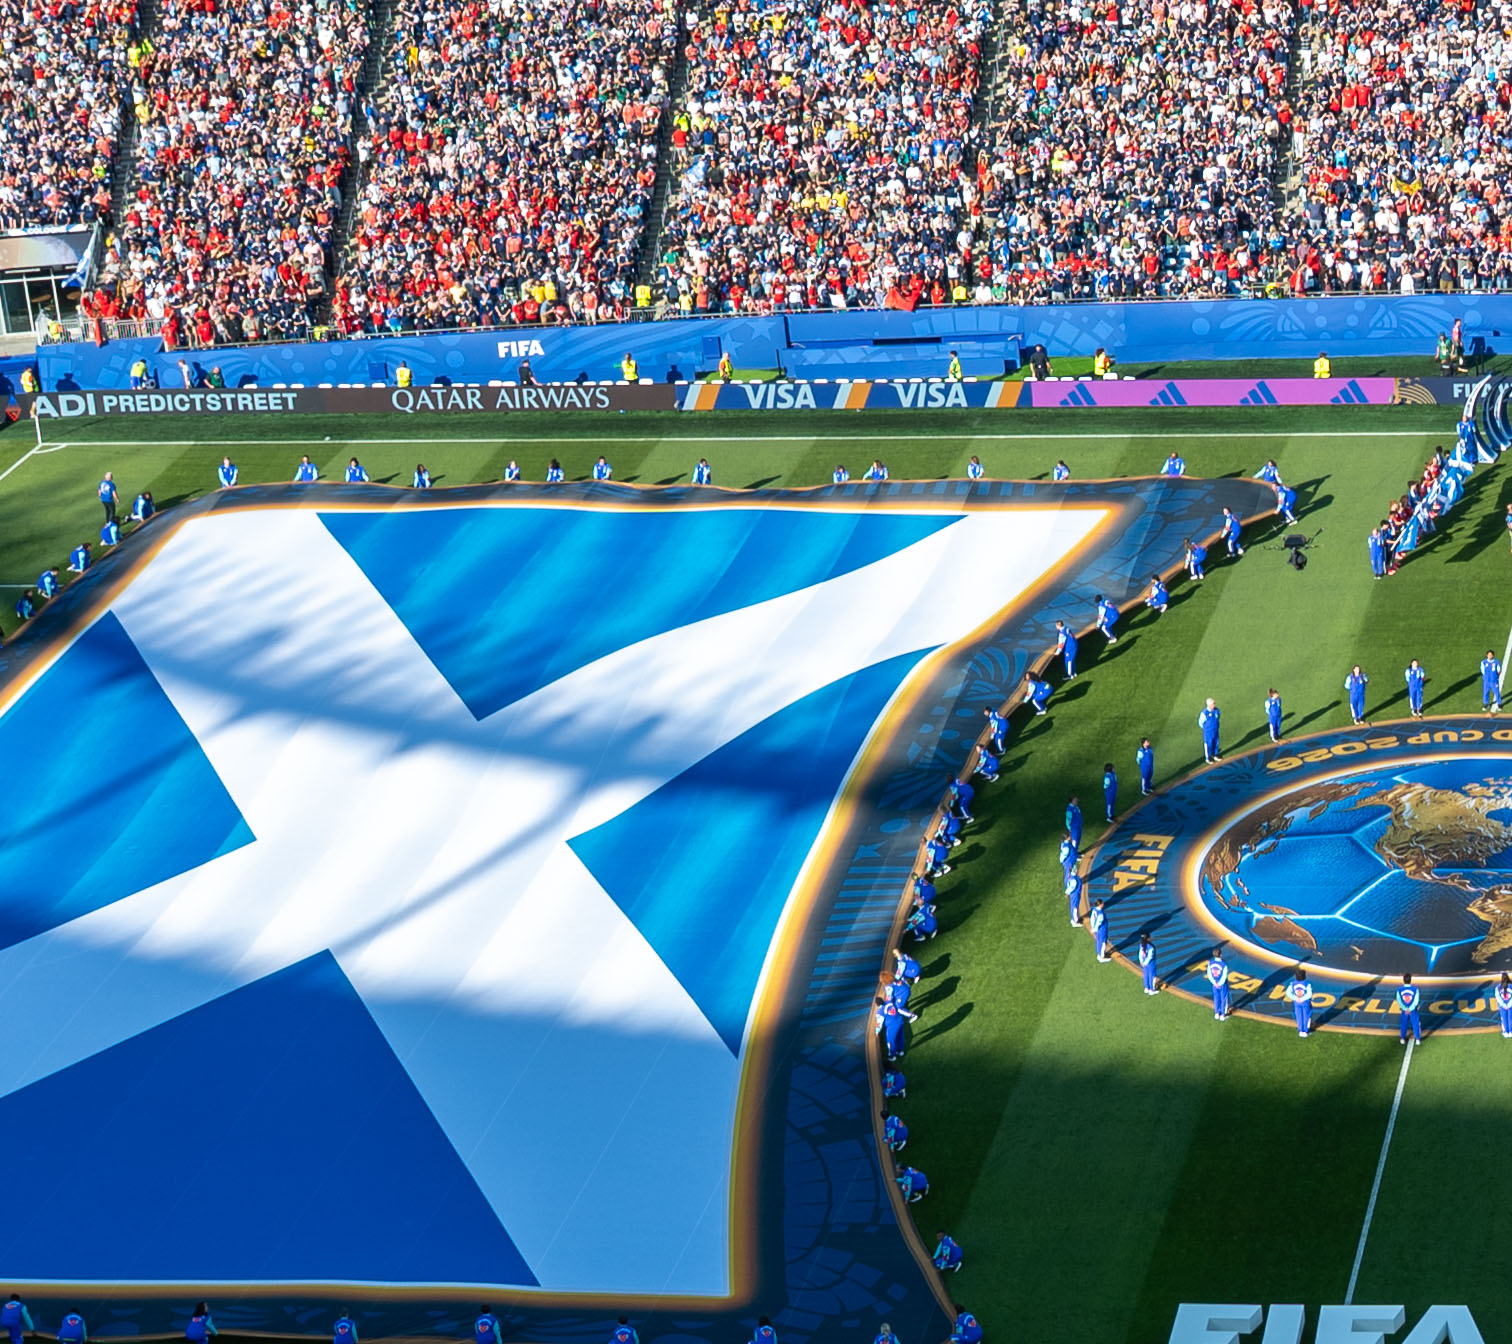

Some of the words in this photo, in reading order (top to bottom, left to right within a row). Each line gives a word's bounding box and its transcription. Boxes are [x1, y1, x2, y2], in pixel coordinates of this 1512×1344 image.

[497, 340, 545, 358] FIFA
[35, 392, 96, 418] ADI
[102, 392, 297, 413] PREDICTSTREET
[391, 388, 484, 413] QATAR
[496, 387, 610, 409] AIRWAYS
[738, 383, 816, 408] VISA
[889, 382, 968, 408] VISA
[1407, 729, 1485, 745] CUP
[1266, 737, 1401, 773] 2026
[1112, 833, 1175, 893] FIFA
[1190, 961, 1266, 992] FFA
